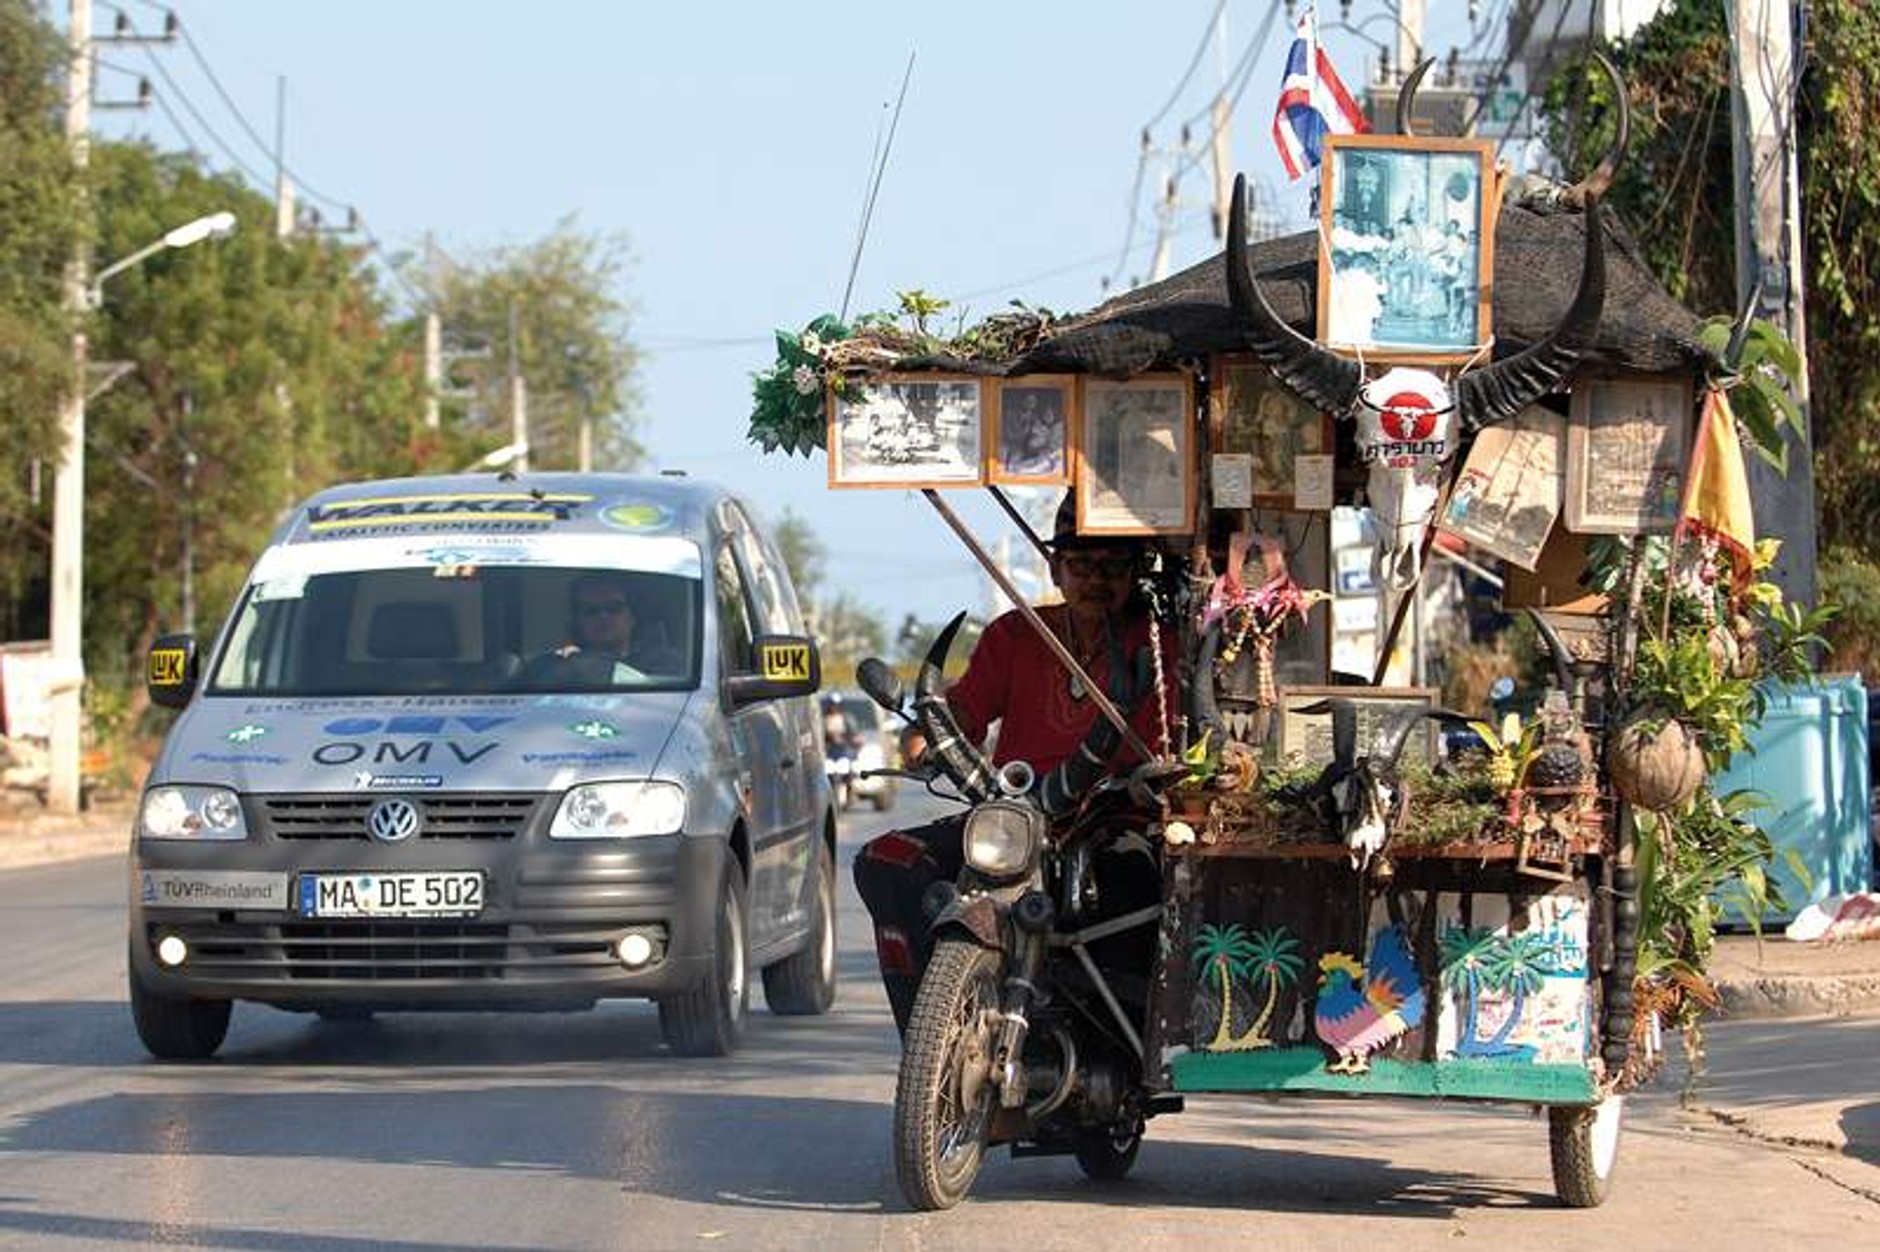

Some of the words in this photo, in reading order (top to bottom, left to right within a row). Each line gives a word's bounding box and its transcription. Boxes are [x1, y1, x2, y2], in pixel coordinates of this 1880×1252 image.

[311, 742, 502, 765] OMV
[319, 879, 359, 909] MA
[379, 878, 419, 908] DE
[425, 876, 480, 907] 502
